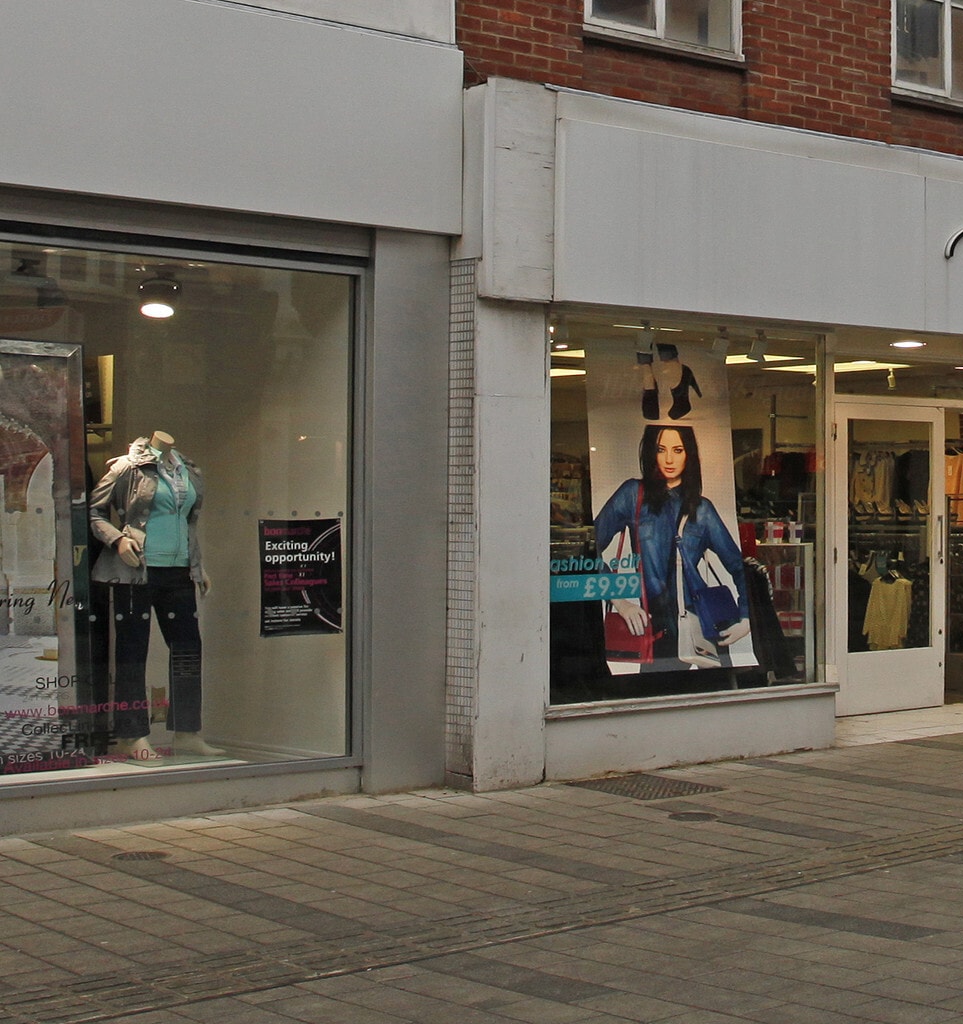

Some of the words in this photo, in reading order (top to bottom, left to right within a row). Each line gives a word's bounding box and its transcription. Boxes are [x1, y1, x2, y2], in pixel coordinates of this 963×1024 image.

[265, 541, 308, 552] Exciting
[265, 552, 335, 564] opportunity!
[556, 579, 579, 588] from
[583, 576, 640, 598] £9.99
[48, 579, 84, 609] Ne
[8, 751, 43, 764] sizes
